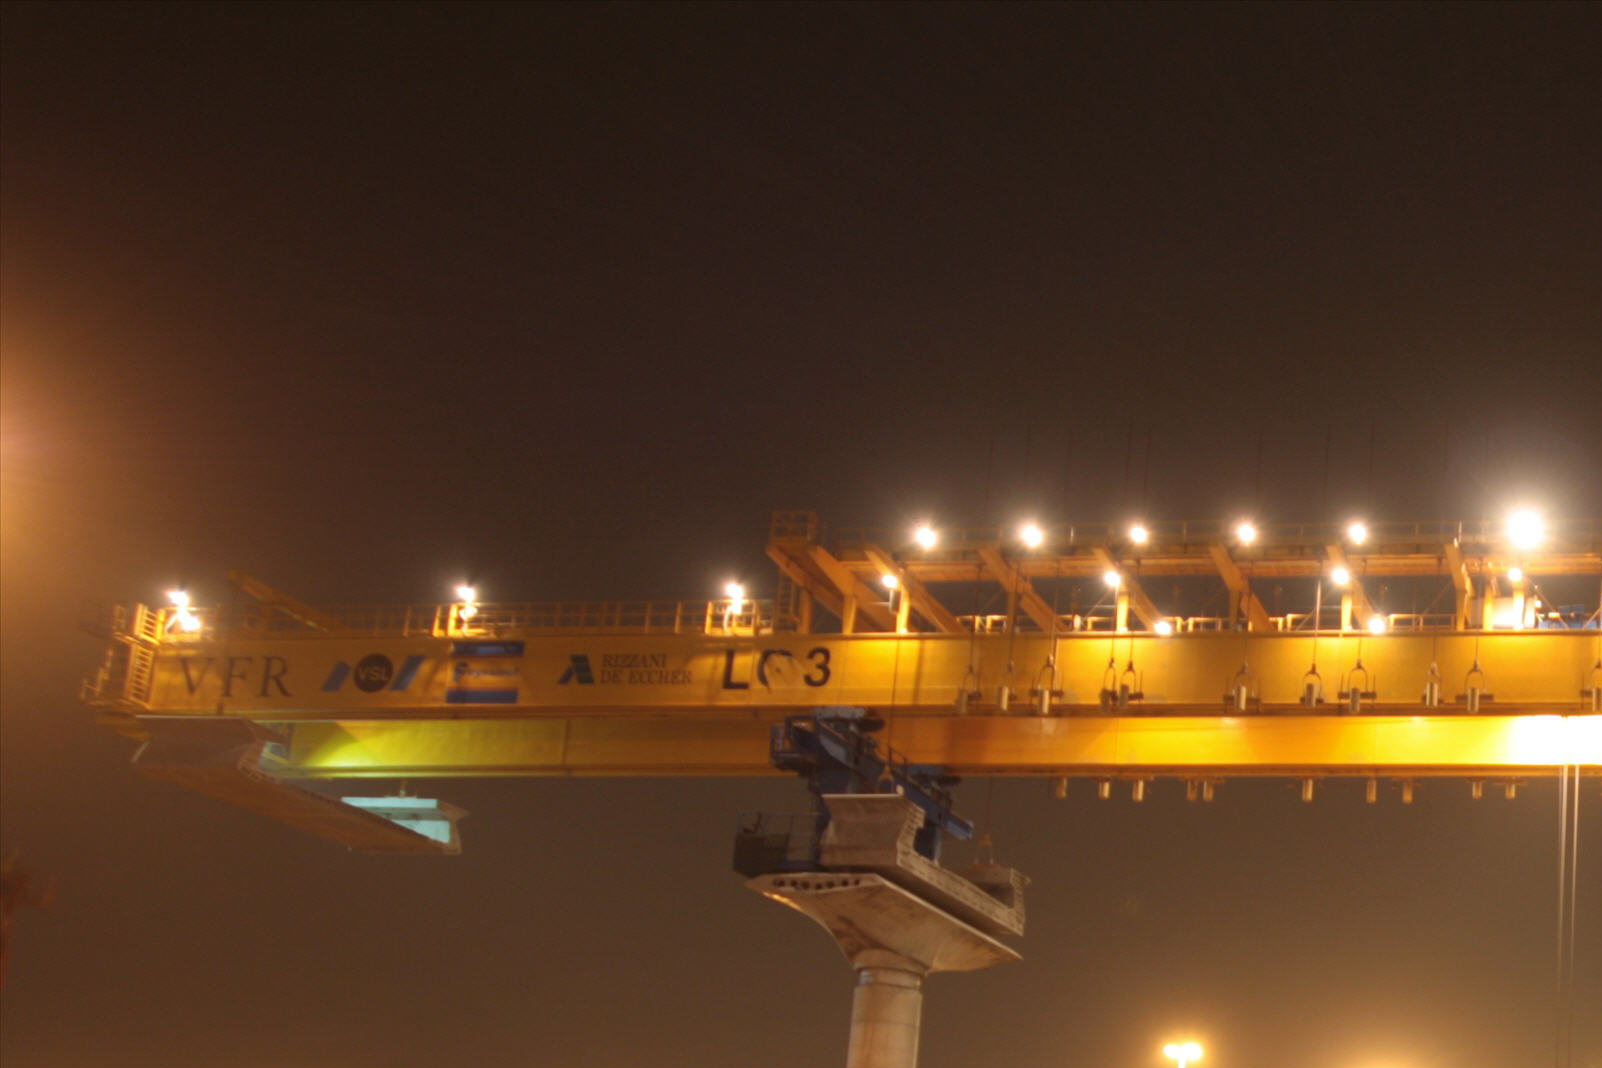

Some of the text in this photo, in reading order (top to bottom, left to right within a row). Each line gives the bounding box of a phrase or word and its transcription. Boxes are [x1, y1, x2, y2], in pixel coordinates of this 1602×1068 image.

[602, 654, 668, 668] RIZZANI
[177, 655, 293, 697] VFR
[358, 665, 389, 682] VSL
